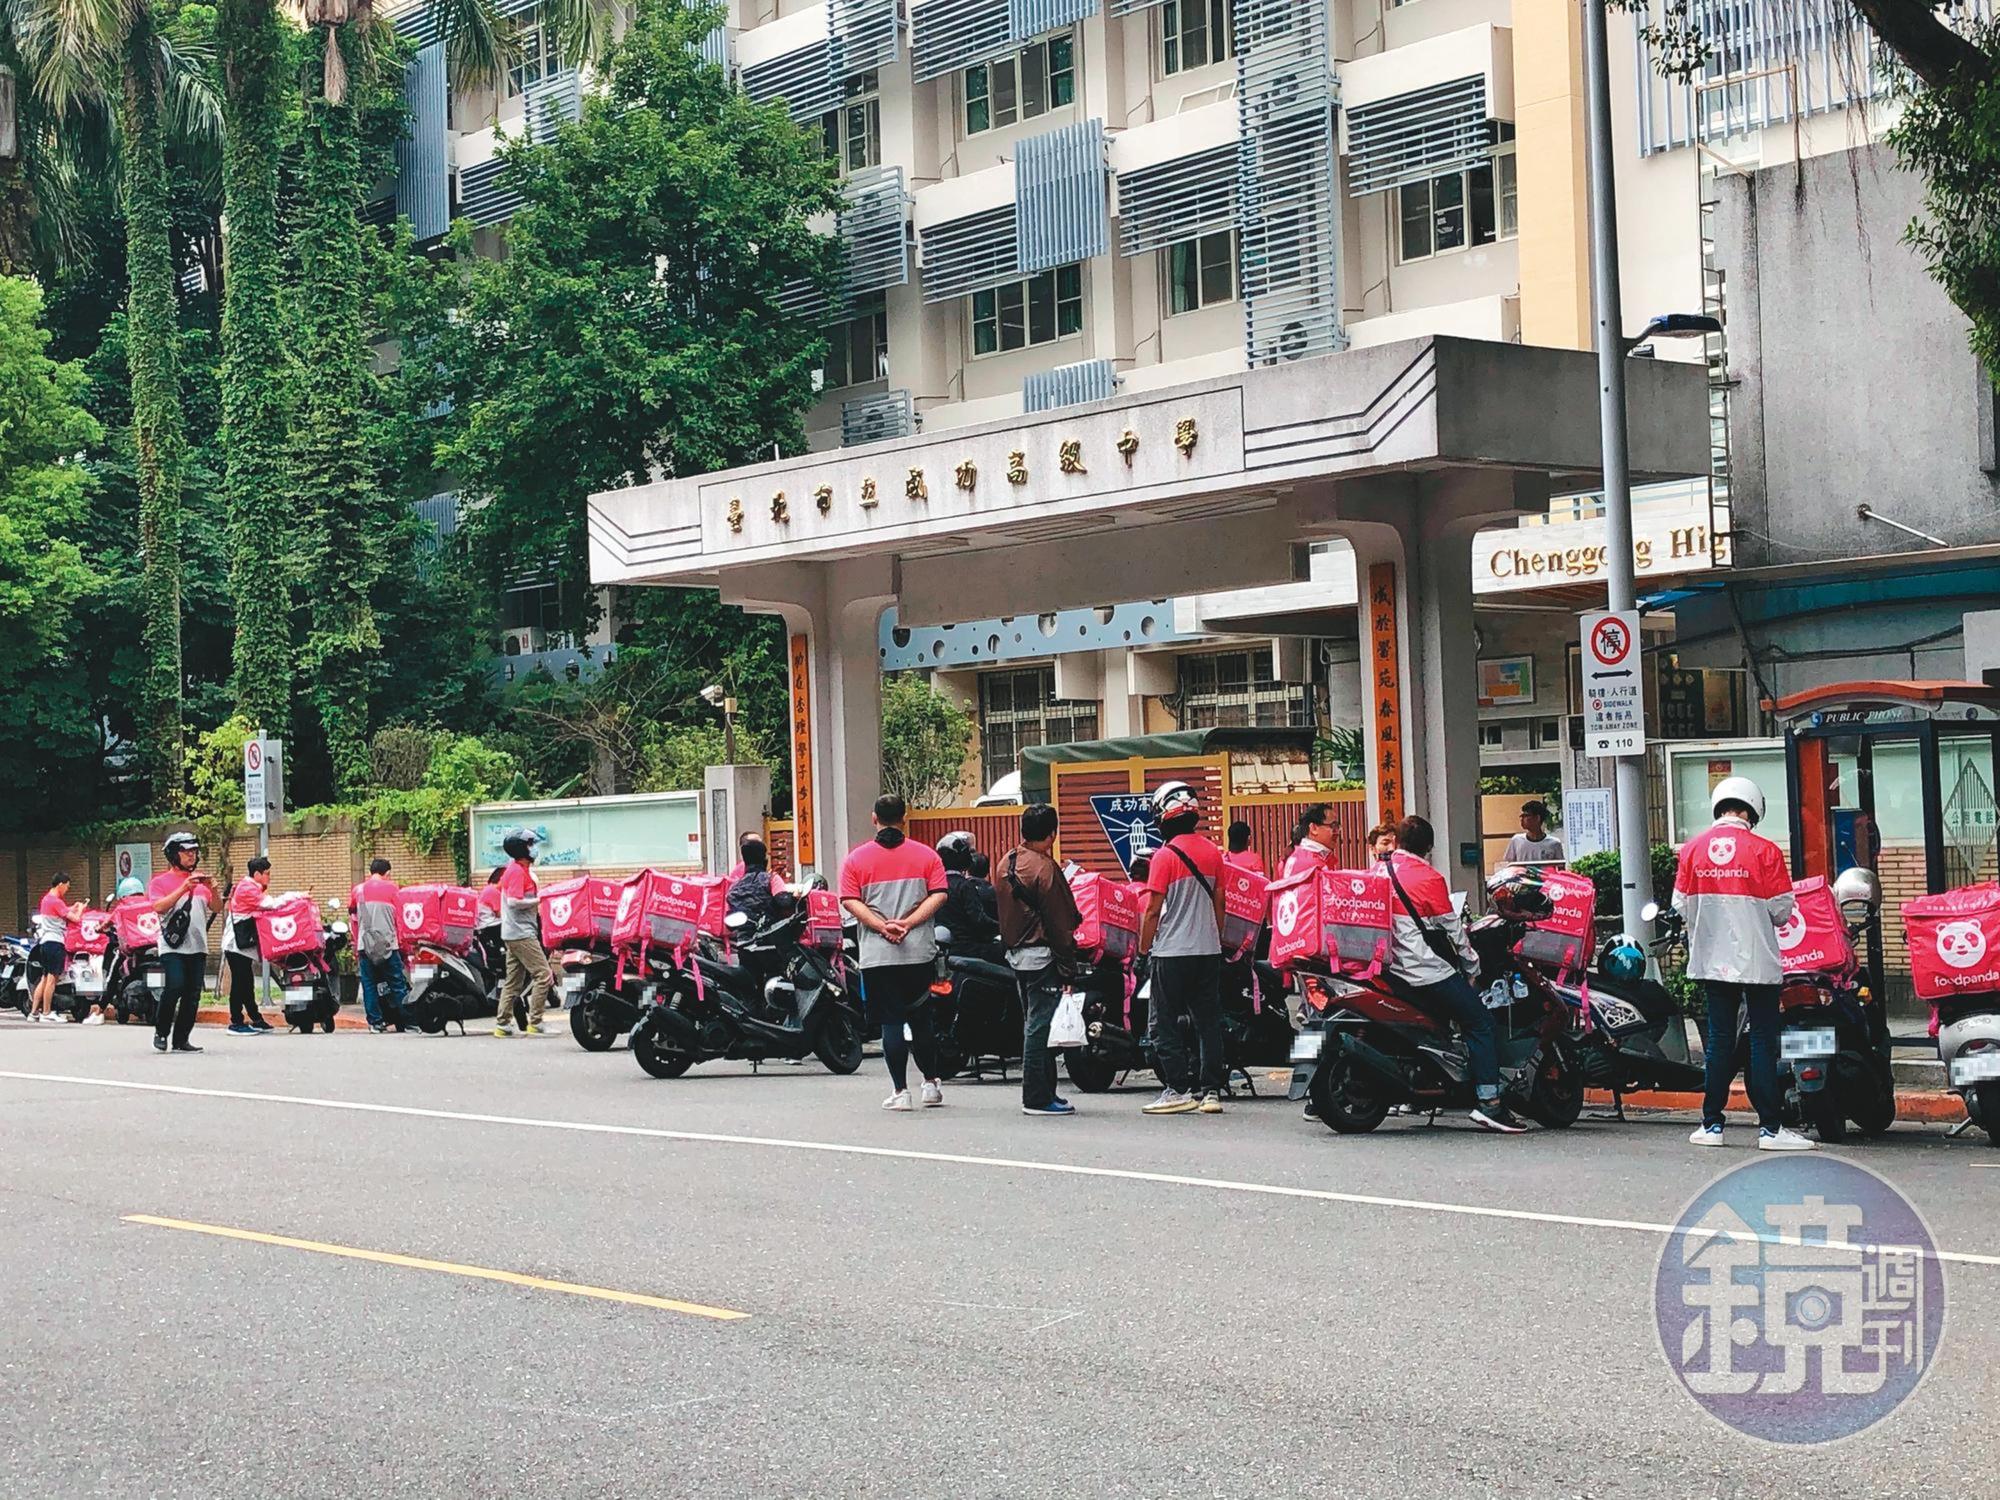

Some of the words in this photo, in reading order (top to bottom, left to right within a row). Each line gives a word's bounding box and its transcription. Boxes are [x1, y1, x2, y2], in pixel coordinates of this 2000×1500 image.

[727, 416, 1199, 533] 臺北市立成功高級中學
[1490, 540, 1653, 578] Chenggg
[1603, 699, 1633, 709] SIDEWALK
[1826, 710, 1864, 723] PUBLIC
[1622, 721, 1638, 729] ZONE
[1616, 738, 1633, 748] 110
[1694, 867, 1750, 881] foodpanda
[653, 891, 697, 910] foodpanda
[1781, 949, 1825, 969] dpanda
